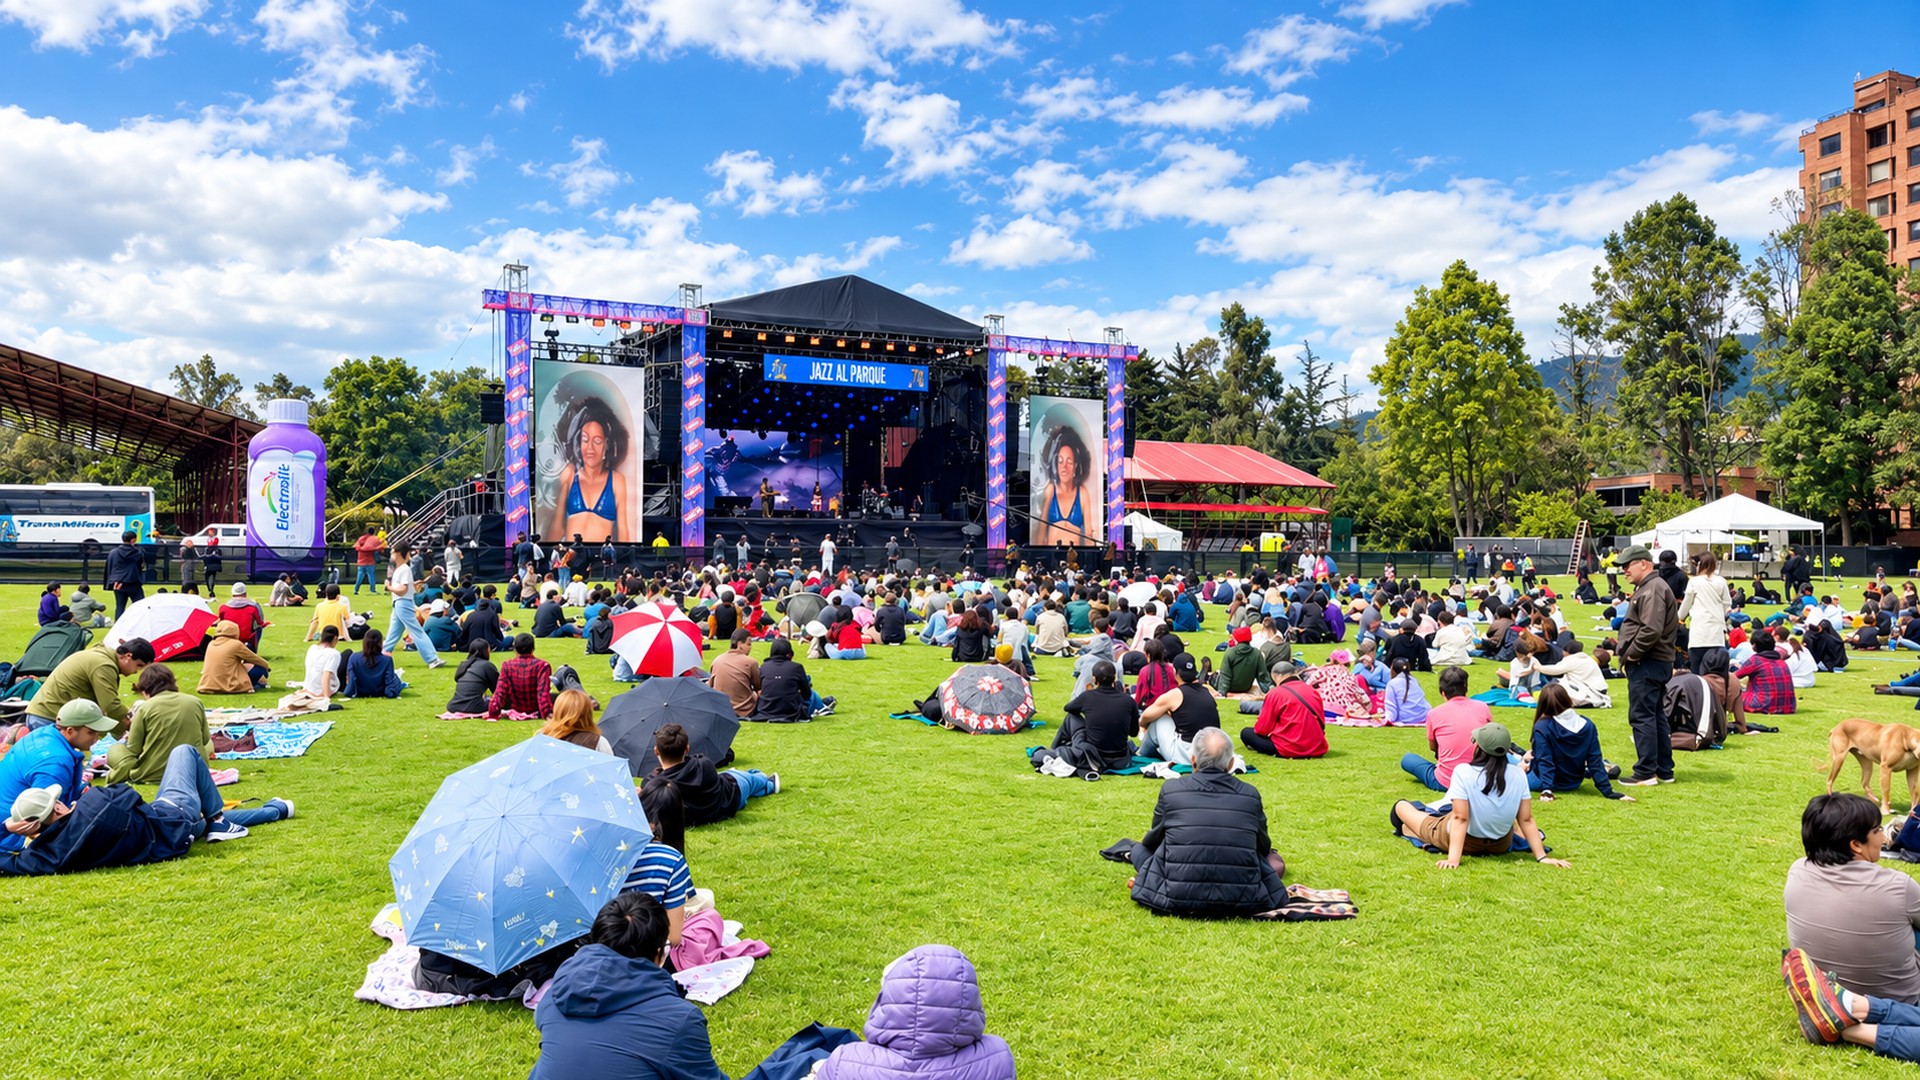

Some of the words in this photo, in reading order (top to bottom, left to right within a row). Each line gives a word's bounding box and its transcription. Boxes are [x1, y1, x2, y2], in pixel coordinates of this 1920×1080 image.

[809, 362, 834, 381] JAZZ
[835, 364, 849, 382] AL
[850, 365, 886, 384] PARQUE
